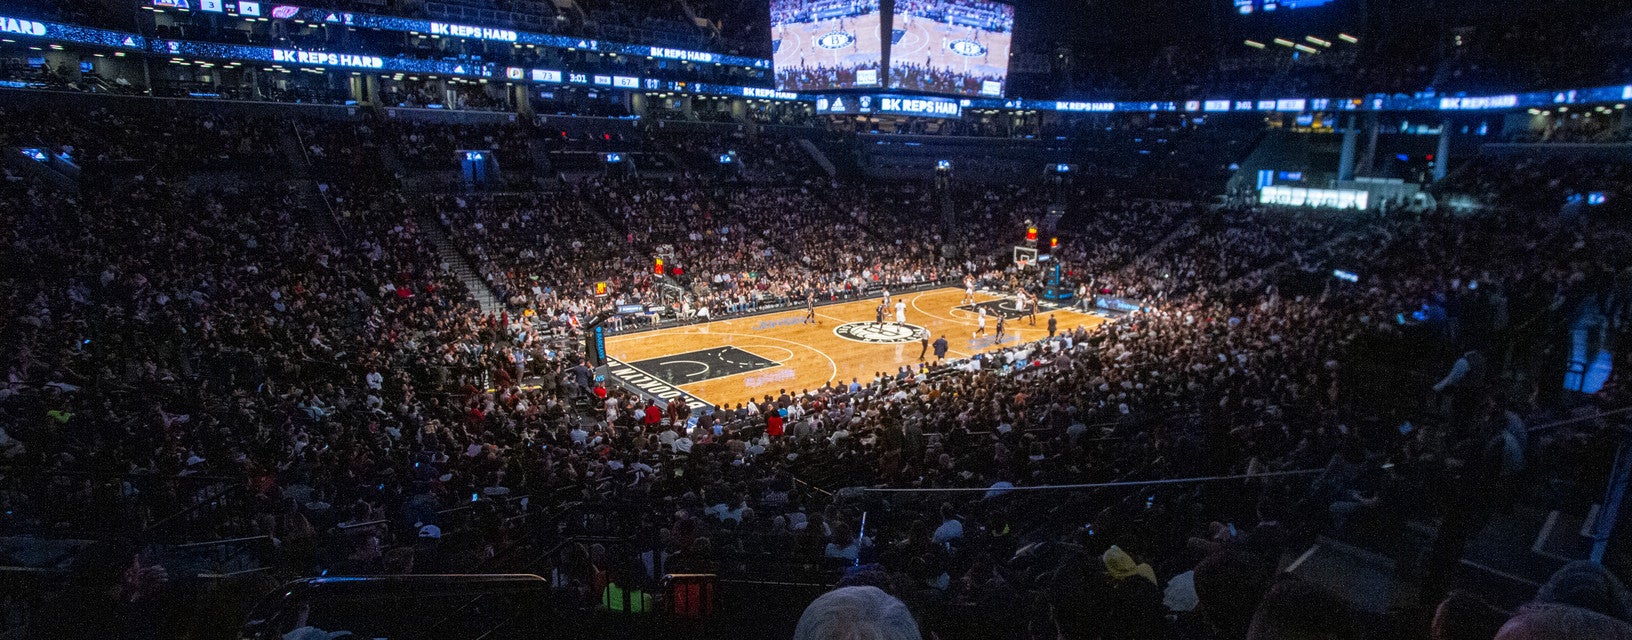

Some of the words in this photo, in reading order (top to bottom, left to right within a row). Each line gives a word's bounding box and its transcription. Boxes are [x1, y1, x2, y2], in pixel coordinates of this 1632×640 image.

[0, 17, 47, 36] HARD
[430, 22, 449, 35] BK
[450, 25, 482, 38] REPS
[483, 28, 517, 41] HARD
[273, 49, 297, 62] BK
[298, 51, 339, 65] REPS
[340, 54, 383, 68] HARD
[650, 47, 664, 57] BK
[664, 48, 687, 60] REPS
[687, 51, 712, 62] HARD
[542, 71, 553, 80] 73
[569, 73, 587, 82] 3:01
[621, 78, 631, 86] 67
[743, 87, 755, 97] BK
[755, 88, 775, 99] REPS
[881, 98, 901, 111] BK
[902, 100, 934, 113] REPS
[1056, 101, 1069, 111] BK
[1069, 102, 1092, 111] REPS
[1092, 102, 1115, 112] HARD
